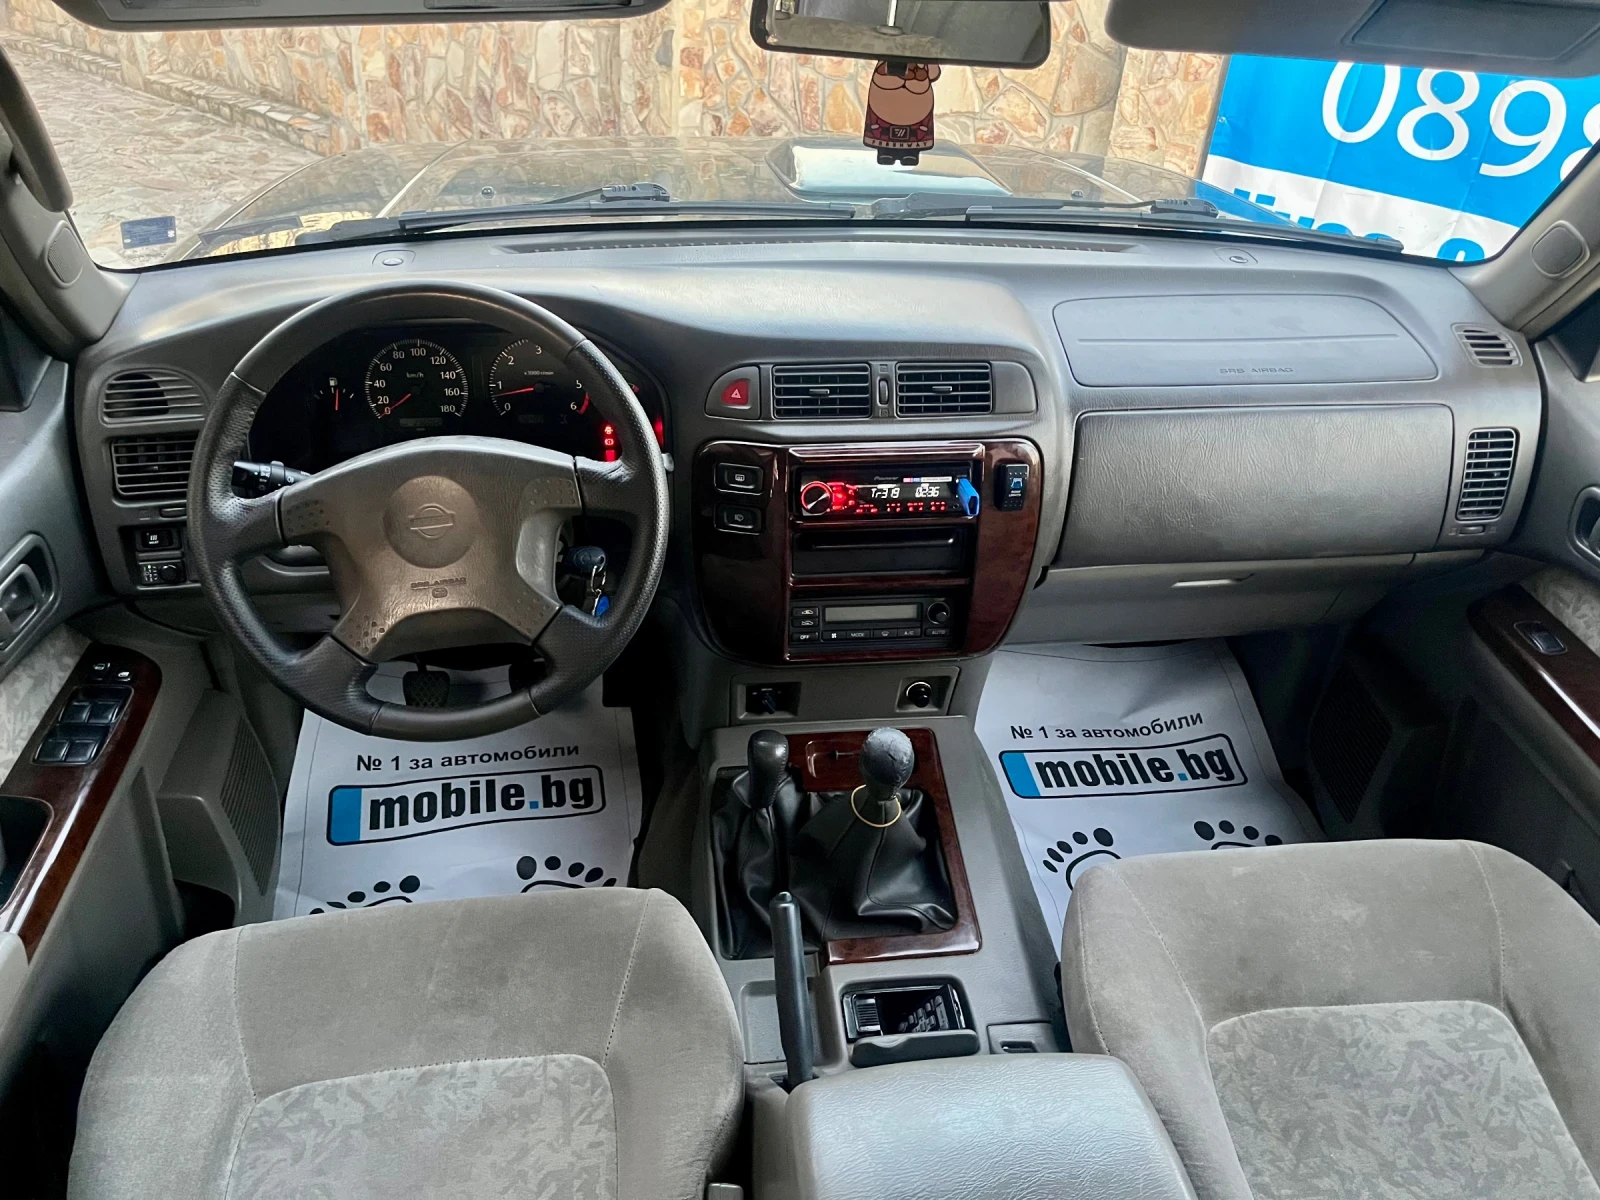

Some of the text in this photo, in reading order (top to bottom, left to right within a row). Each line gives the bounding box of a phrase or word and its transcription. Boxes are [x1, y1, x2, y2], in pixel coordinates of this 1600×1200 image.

[393, 350, 404, 359] 80
[410, 348, 426, 356] 100
[536, 346, 542, 355] 3
[430, 356, 446, 365] 120
[507, 356, 514, 365] 2
[380, 363, 392, 371] 60
[440, 371, 456, 380] 140
[374, 380, 386, 388] 40
[497, 381, 502, 390] 1
[576, 380, 582, 389] 5
[444, 388, 460, 396] 160
[377, 396, 389, 404] 20
[384, 406, 391, 415] 0
[440, 405, 456, 413] 180
[504, 403, 511, 411] 0
[570, 402, 577, 410] 6
[1038, 726, 1048, 739] 1
[1055, 726, 1077, 738] за
[1081, 712, 1203, 739] автомобили
[390, 756, 401, 770] 1
[409, 755, 433, 770] за
[440, 744, 580, 767] автомобили
[1035, 747, 1235, 788] mobile.bg
[368, 774, 595, 831] mobile.bg
